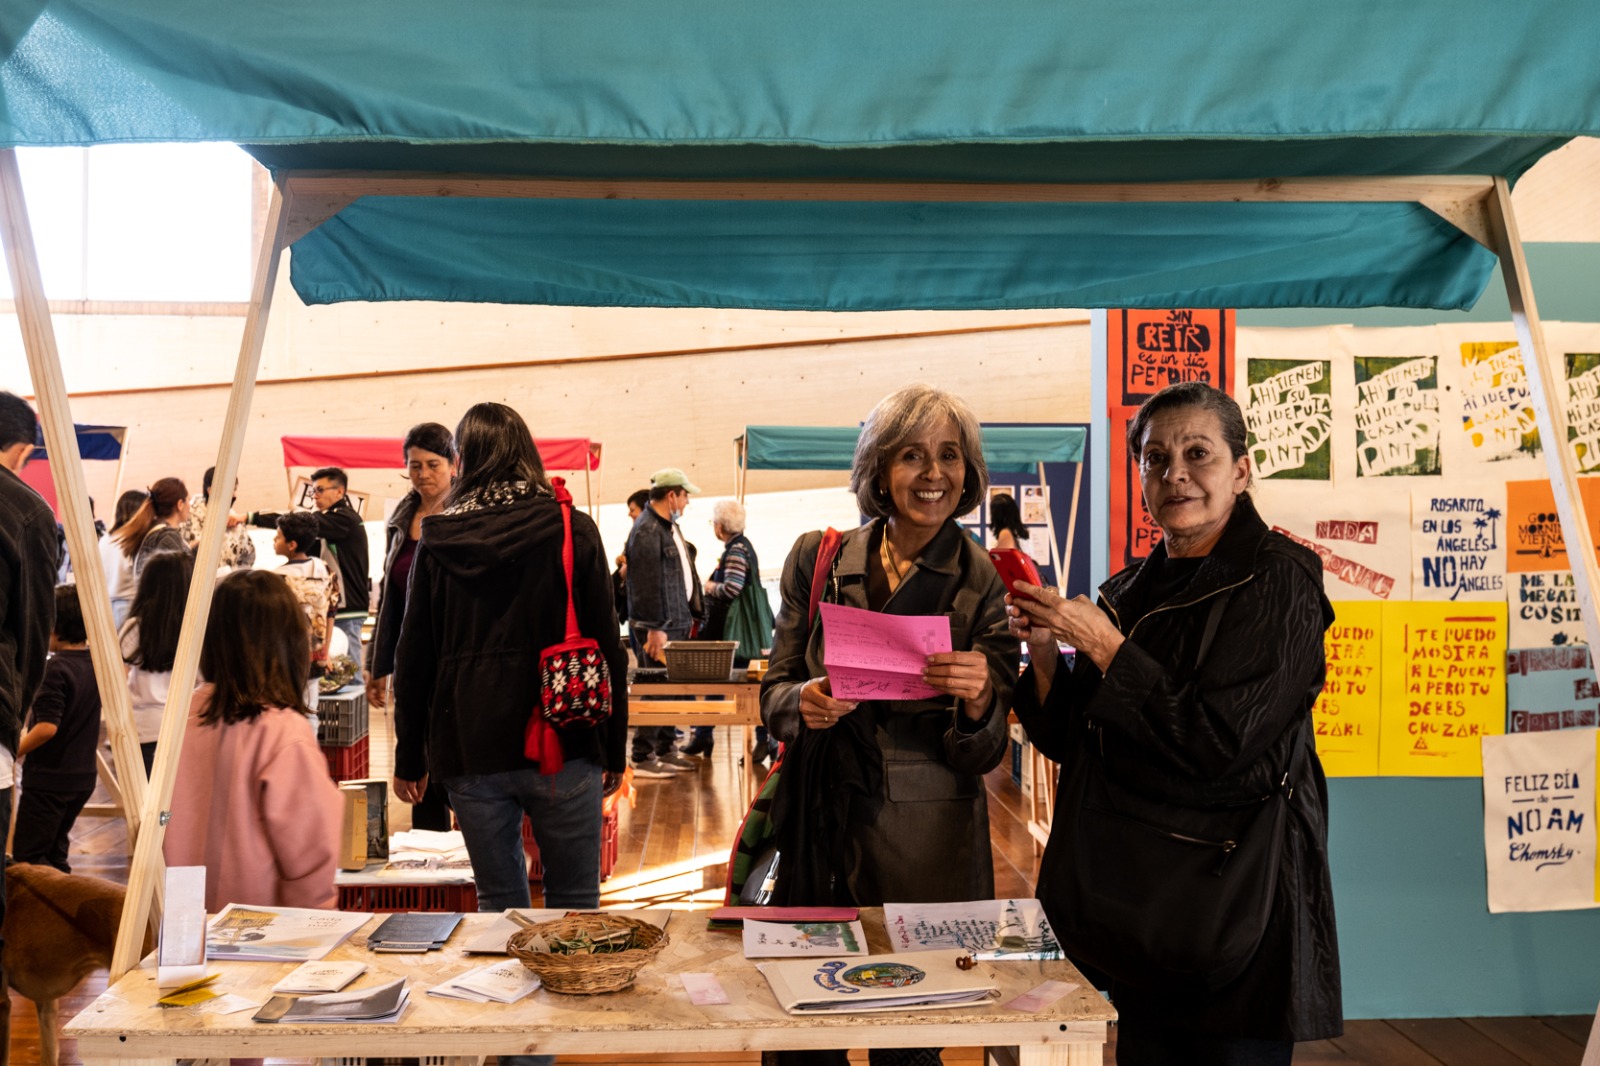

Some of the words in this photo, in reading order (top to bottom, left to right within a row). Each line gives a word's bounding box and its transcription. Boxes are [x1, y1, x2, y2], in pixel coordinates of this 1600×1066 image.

[1166, 310, 1193, 324] SIN
[1138, 352, 1158, 364] es
[1161, 354, 1178, 365] un
[1131, 364, 1211, 386] PERDIDO
[1275, 364, 1322, 391] TIENEN
[1291, 390, 1306, 403] SU
[1258, 425, 1295, 442] CASA
[1367, 420, 1404, 440] CASA
[1430, 498, 1485, 513] ROSARITO
[1316, 520, 1379, 544] NADA
[1422, 519, 1438, 534] EN
[1441, 519, 1462, 534] LOS
[1422, 555, 1457, 588] NO
[1460, 555, 1487, 571] HAY
[1521, 574, 1545, 587] ME
[1520, 604, 1583, 624] COSIT
[1328, 626, 1374, 640] UEDO
[1415, 629, 1438, 642] TE
[1445, 628, 1496, 642] PUEDO
[1412, 644, 1489, 661] MOSTRA
[1346, 681, 1366, 695] TU
[1426, 681, 1465, 695] PERO
[1471, 681, 1490, 695] TU
[1504, 773, 1549, 793] FELIZ
